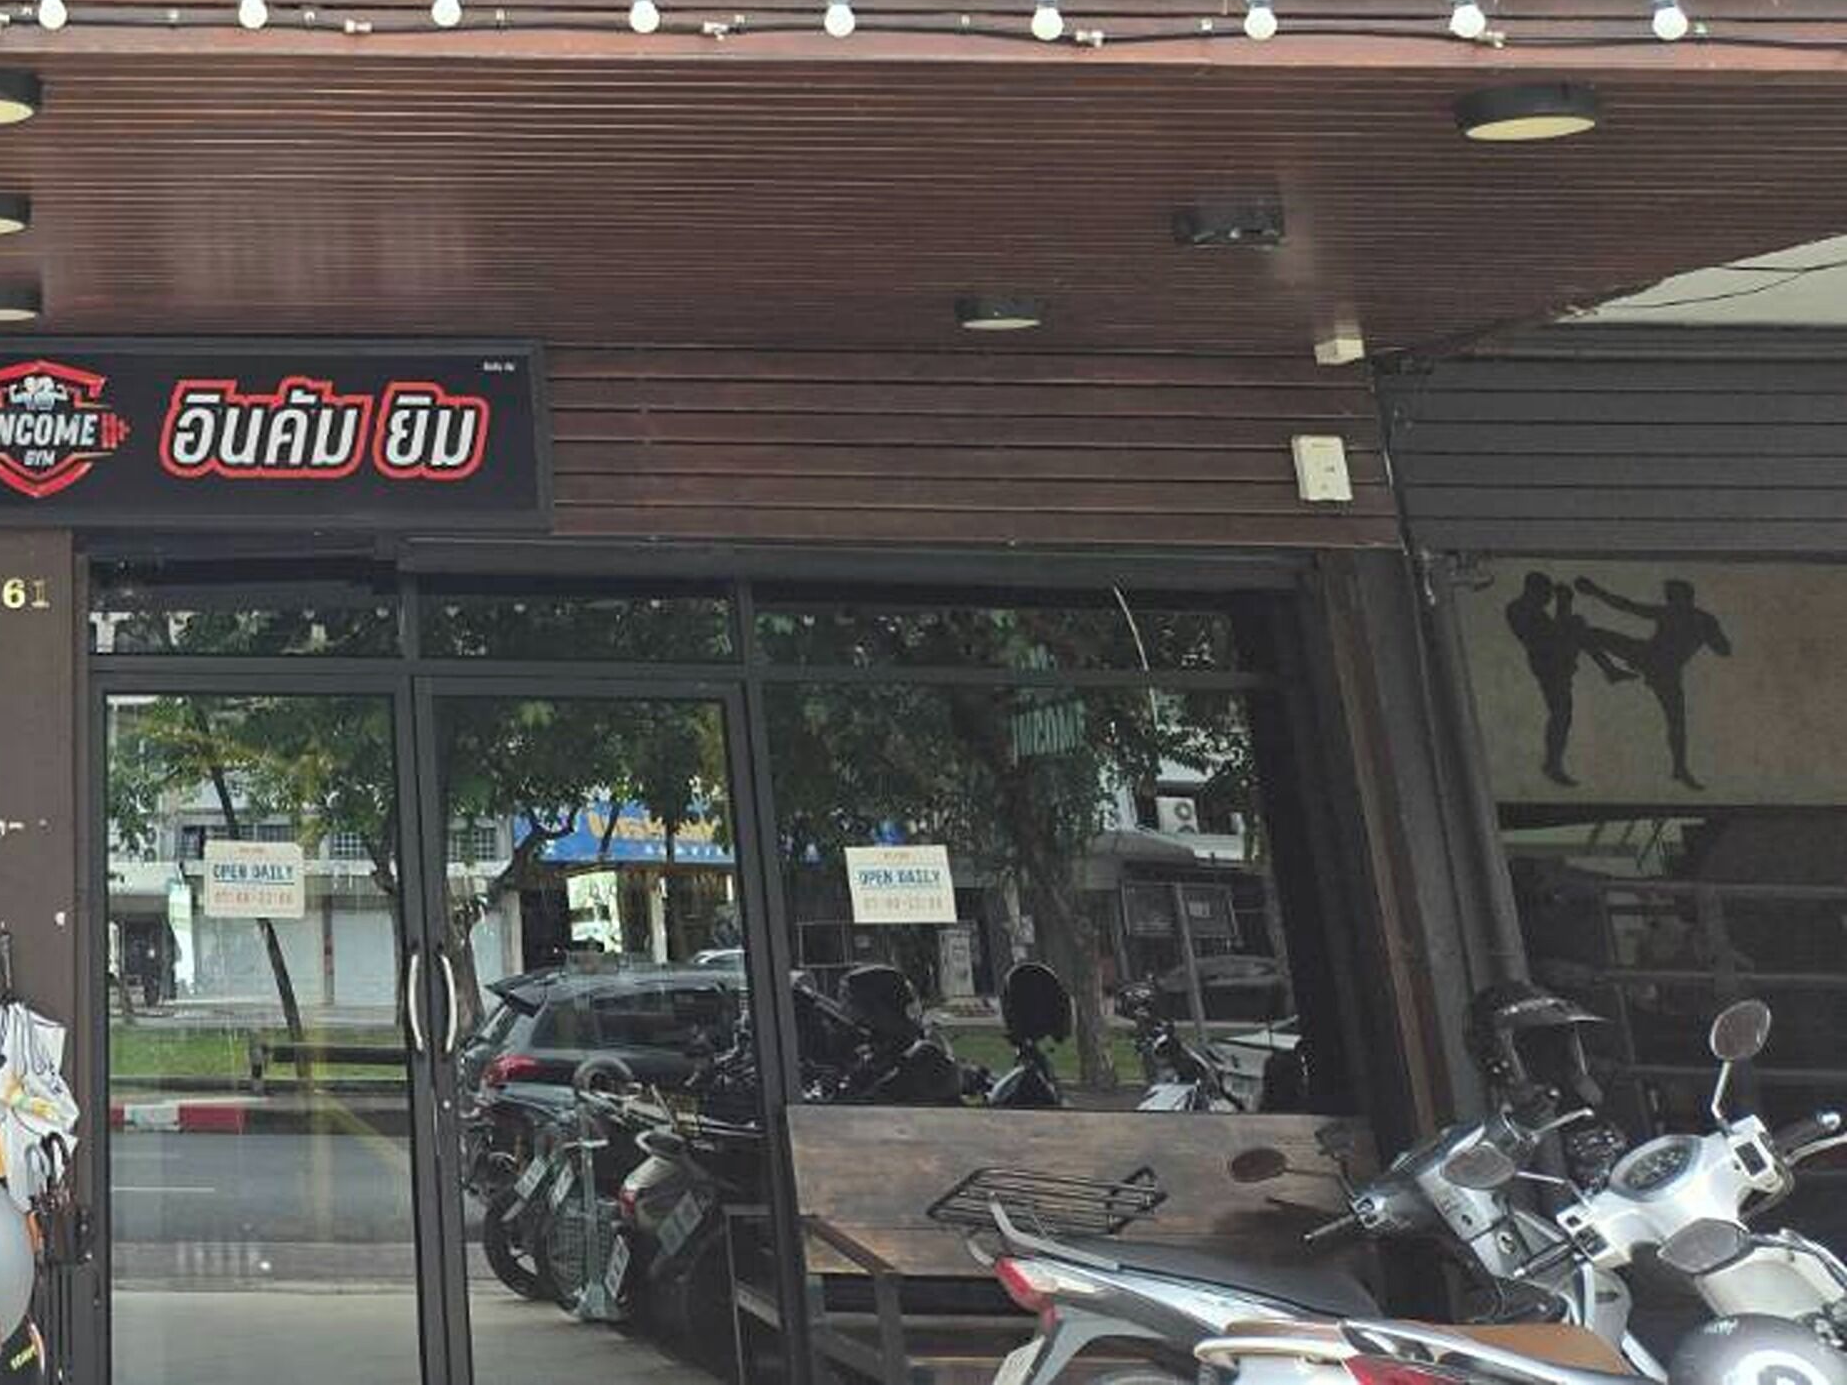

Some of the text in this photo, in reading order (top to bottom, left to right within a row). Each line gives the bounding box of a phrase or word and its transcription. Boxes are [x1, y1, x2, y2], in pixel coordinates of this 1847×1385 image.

[172, 388, 476, 467] อินคัม ยิม
[23, 450, 56, 465] GYM
[2, 577, 51, 609] 61
[214, 864, 294, 880] OPEN DAILY
[858, 868, 941, 885] OPEN DAILY
